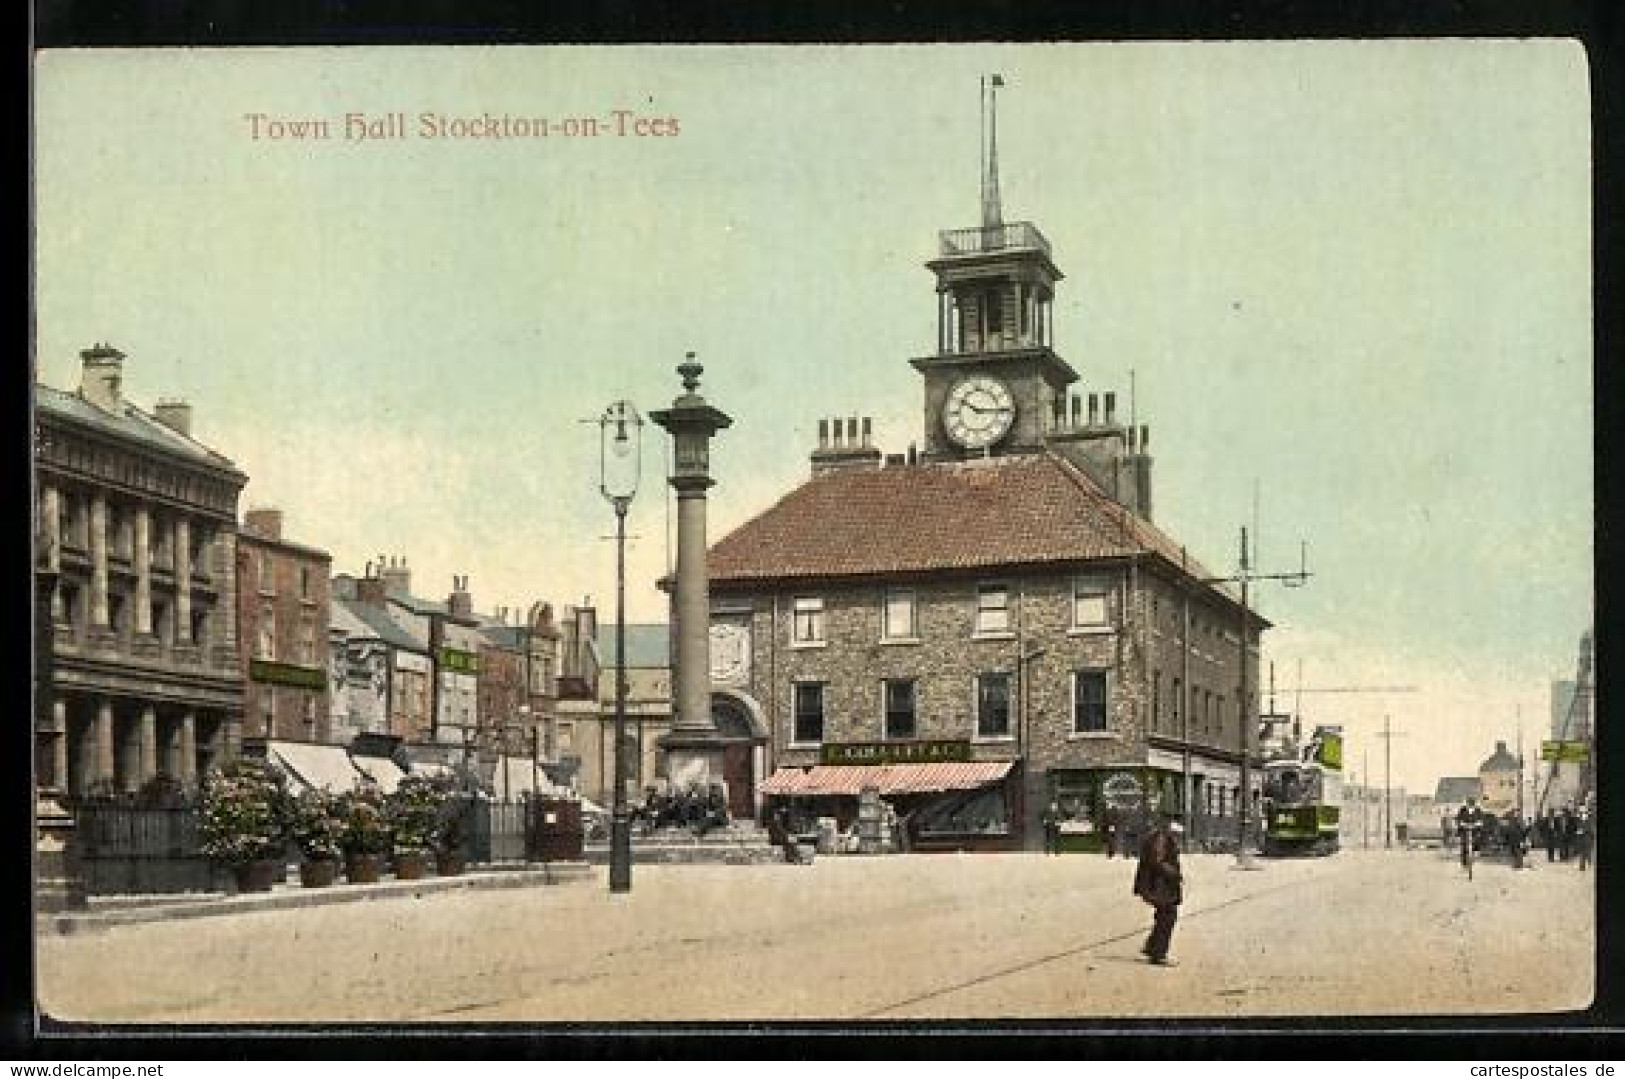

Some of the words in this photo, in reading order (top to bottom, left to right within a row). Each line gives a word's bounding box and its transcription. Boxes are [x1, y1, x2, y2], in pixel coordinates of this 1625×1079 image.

[244, 113, 331, 140] Town
[345, 112, 405, 144] Hall
[418, 109, 681, 140] Stockton-on-Tees
